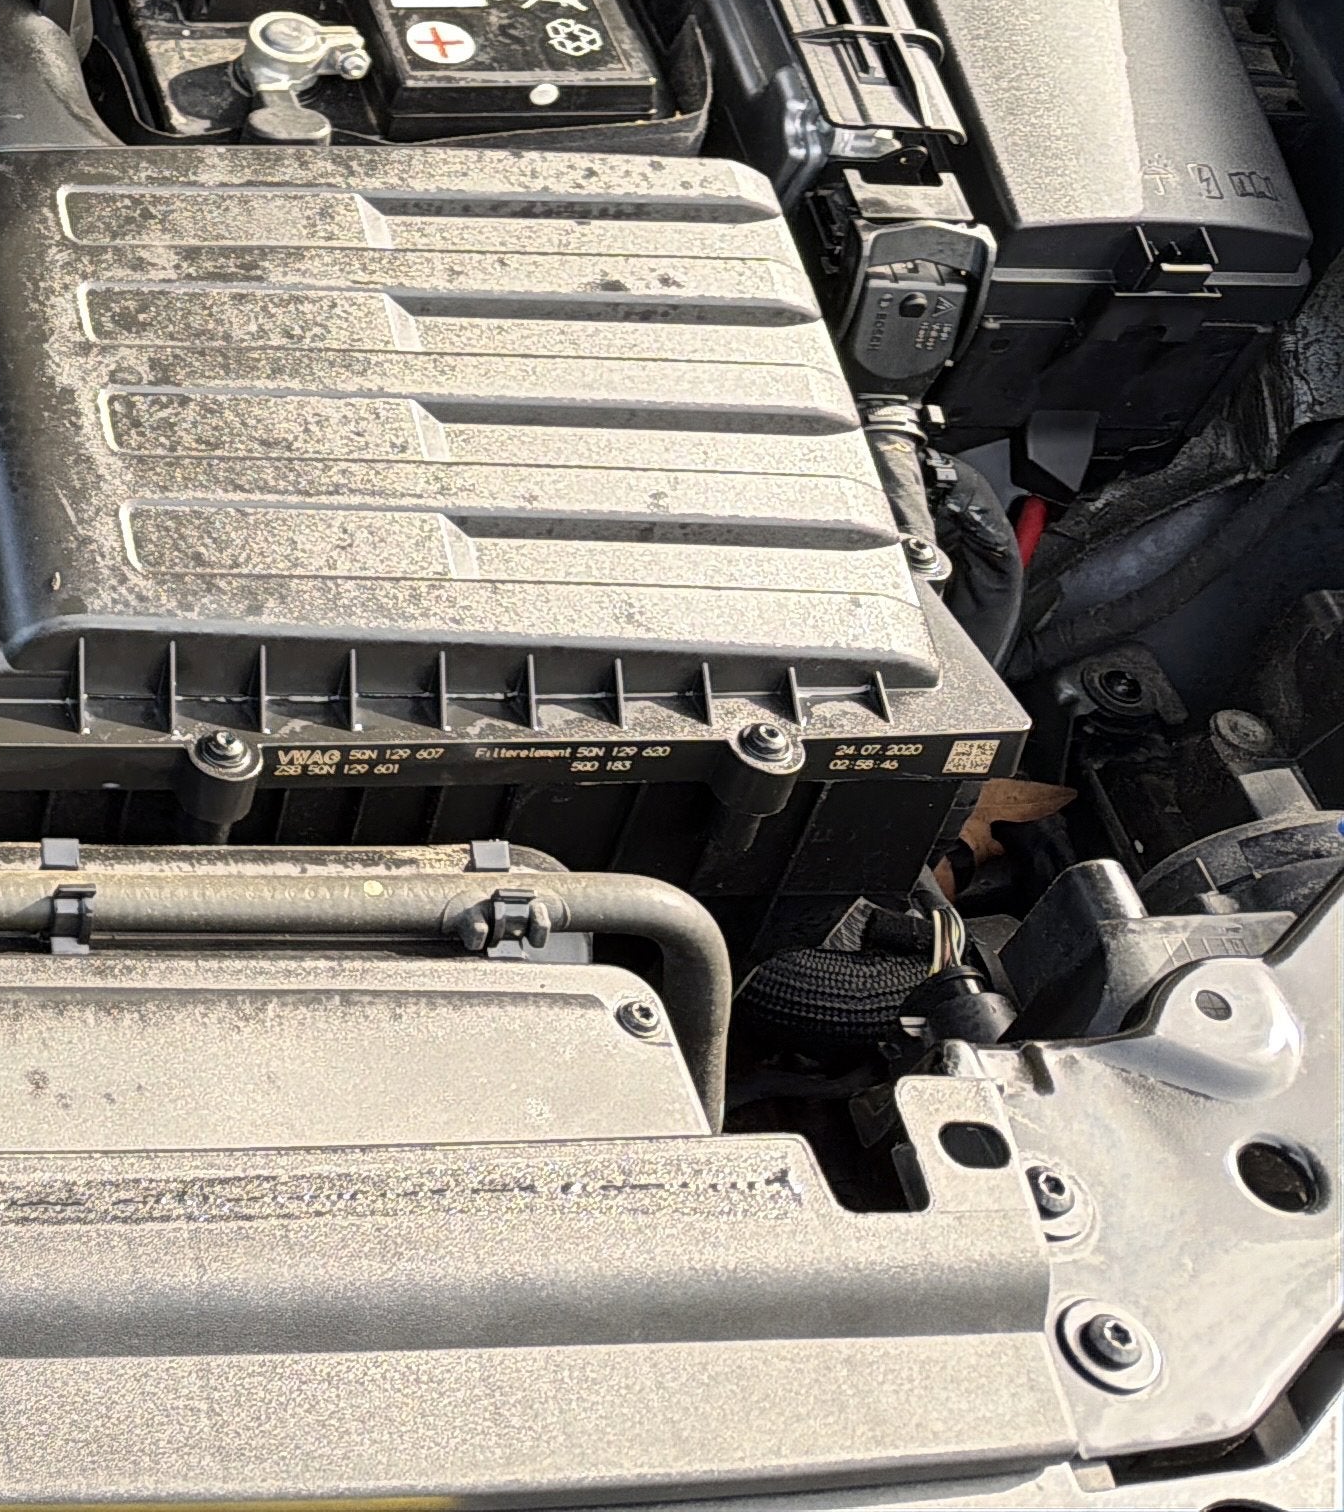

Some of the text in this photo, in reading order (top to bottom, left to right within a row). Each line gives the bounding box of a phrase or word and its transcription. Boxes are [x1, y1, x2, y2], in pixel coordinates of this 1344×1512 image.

[385, 749, 411, 760] 129
[415, 748, 445, 759] 607
[474, 747, 572, 759] Filterelement
[611, 746, 638, 757] 129
[641, 746, 671, 757] 620
[834, 744, 923, 756] 24.07.2020
[343, 764, 369, 775] 129
[373, 763, 400, 774] 601
[606, 760, 632, 771] 183
